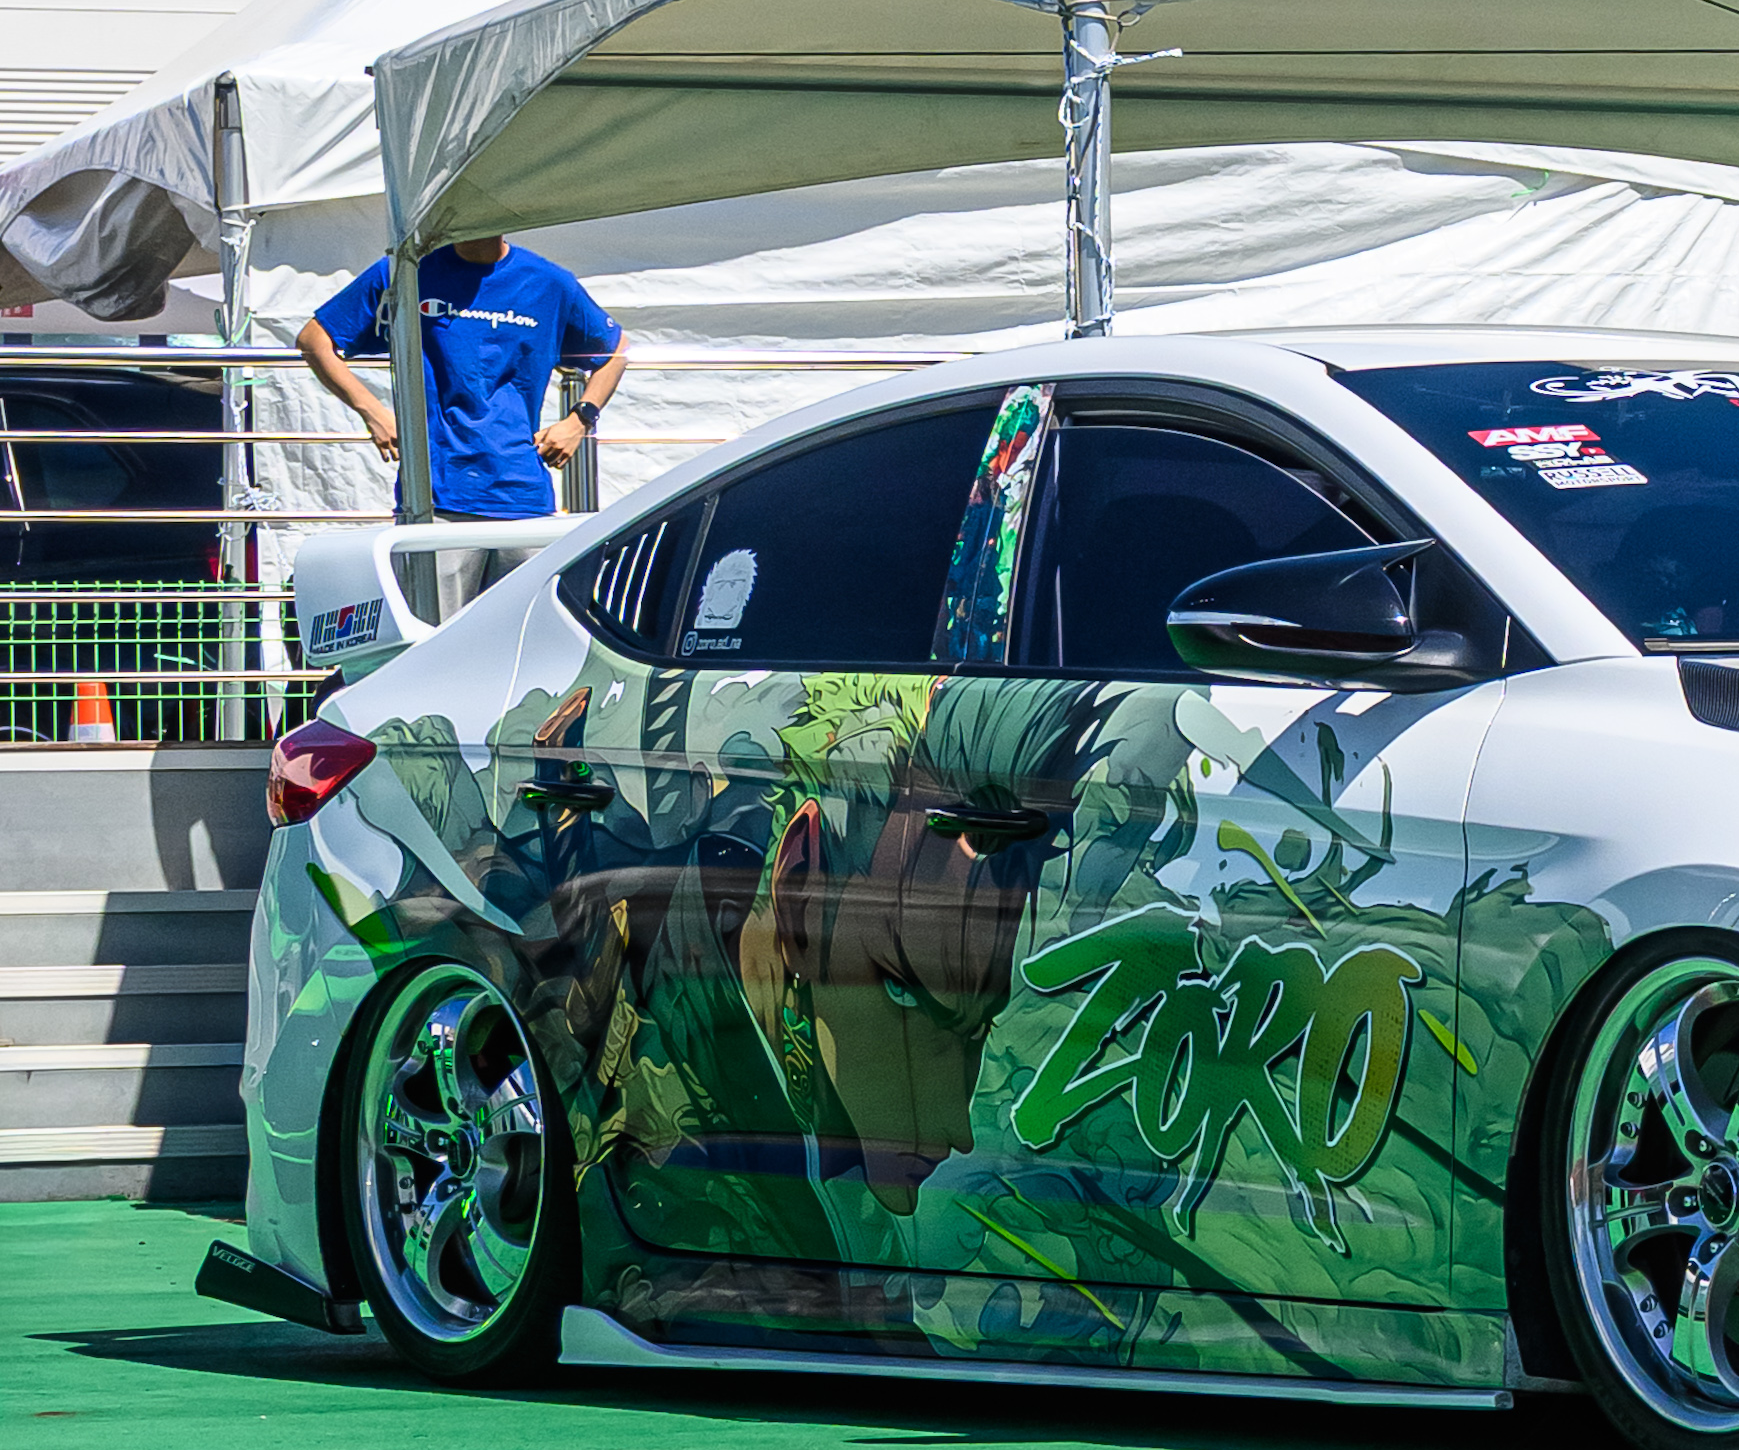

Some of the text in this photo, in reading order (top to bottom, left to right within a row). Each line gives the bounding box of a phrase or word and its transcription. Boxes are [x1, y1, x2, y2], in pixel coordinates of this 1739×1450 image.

[419, 298, 538, 329] Champion
[1483, 424, 1589, 447] AMF
[1507, 441, 1582, 462] SSY
[1544, 467, 1637, 482] RUSSELL
[1011, 901, 1428, 1253] ZORO
[213, 1246, 255, 1273] VELOCE
